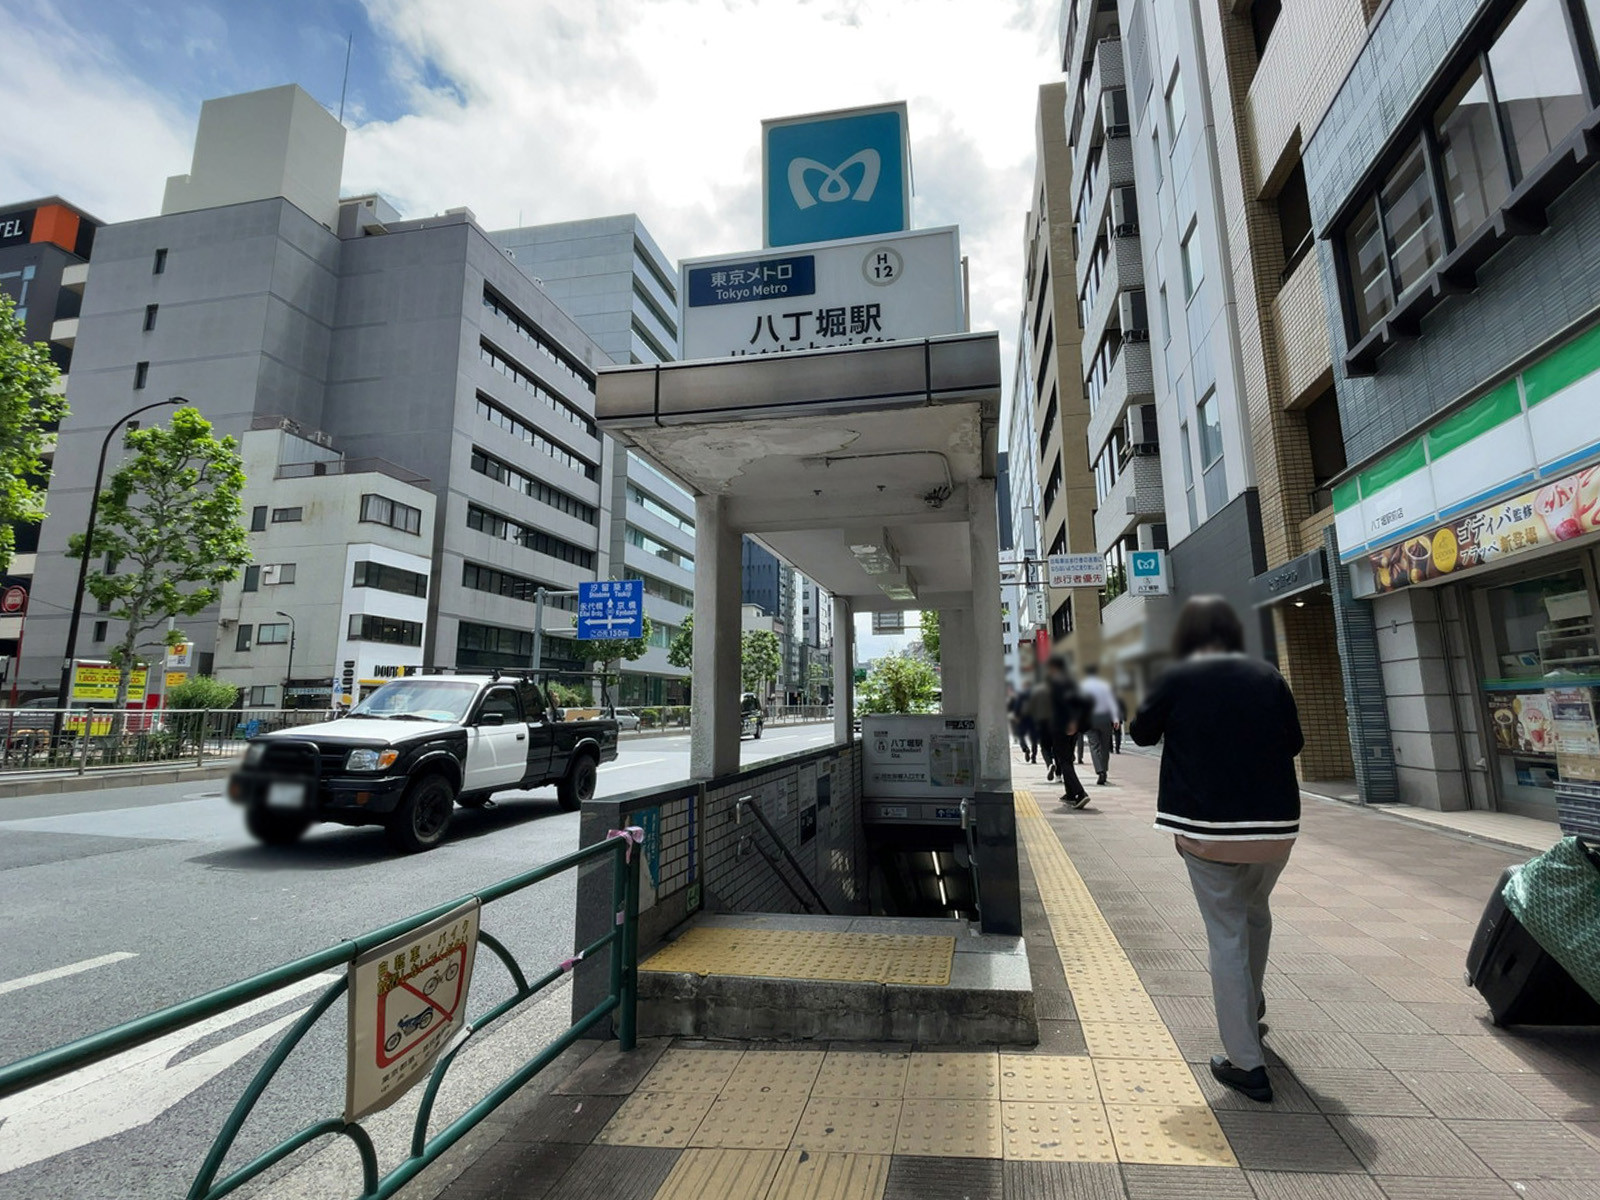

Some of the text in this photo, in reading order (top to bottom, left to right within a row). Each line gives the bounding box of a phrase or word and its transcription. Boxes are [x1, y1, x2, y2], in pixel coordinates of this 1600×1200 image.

[876, 253, 888, 264] H
[710, 264, 792, 287] 東京メトロ
[874, 267, 893, 279] 12
[716, 283, 788, 300] Tokyo Metro
[749, 303, 882, 344] 八丁堀駅
[1053, 573, 1103, 584] 歩行者優先
[378, 919, 469, 979] 自転車・バイク
